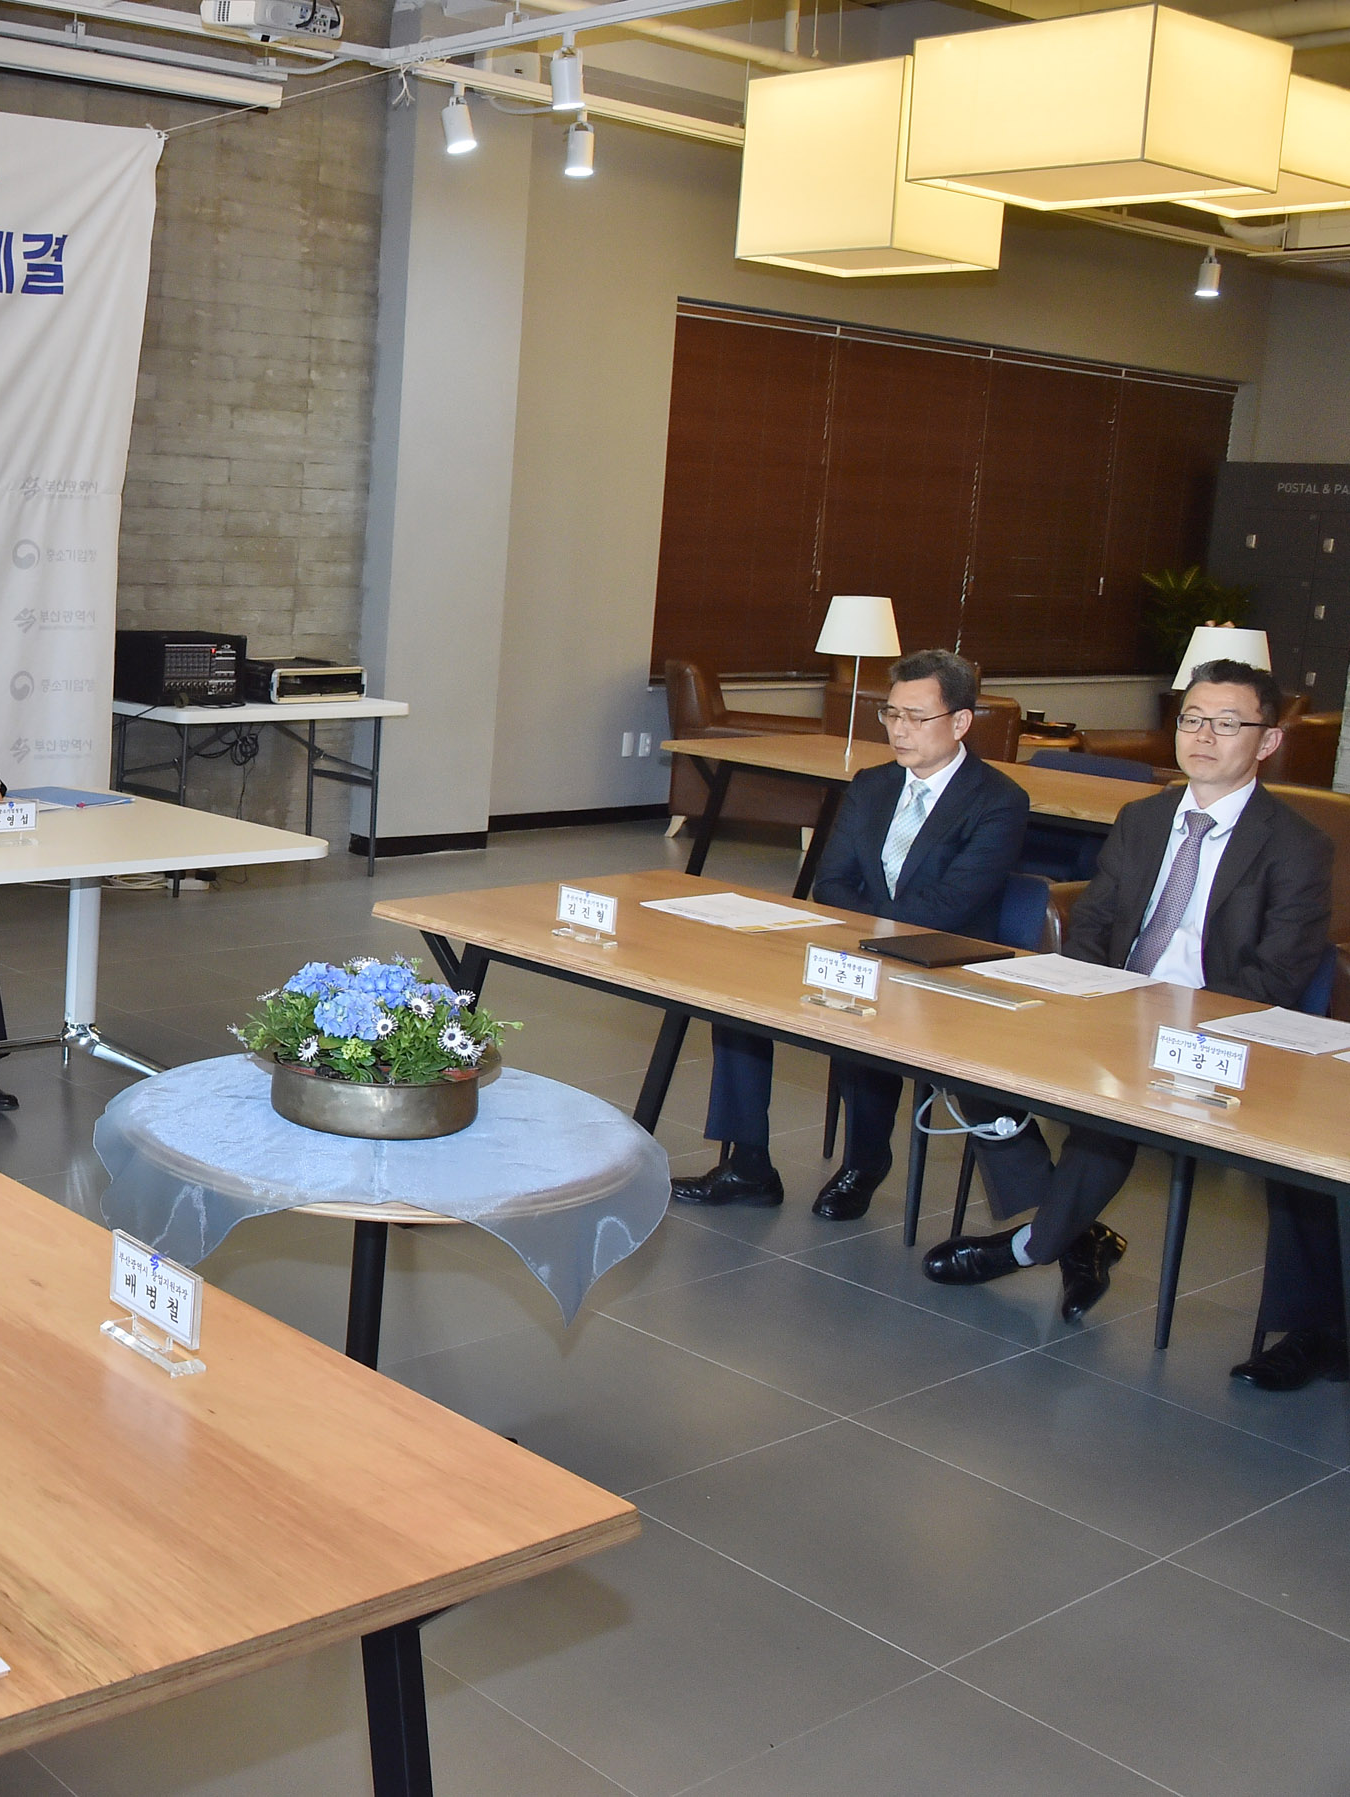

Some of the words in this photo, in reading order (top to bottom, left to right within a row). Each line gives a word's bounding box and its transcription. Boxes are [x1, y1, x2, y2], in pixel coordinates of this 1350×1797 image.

[1277, 482, 1319, 494] POSTAL
[1322, 483, 1331, 494] &
[568, 902, 604, 923] 김진형
[818, 965, 865, 989] 이준희
[1169, 1047, 1229, 1076] 이광식
[118, 1250, 149, 1278] 부산광역시
[124, 1272, 179, 1324] 배병철
